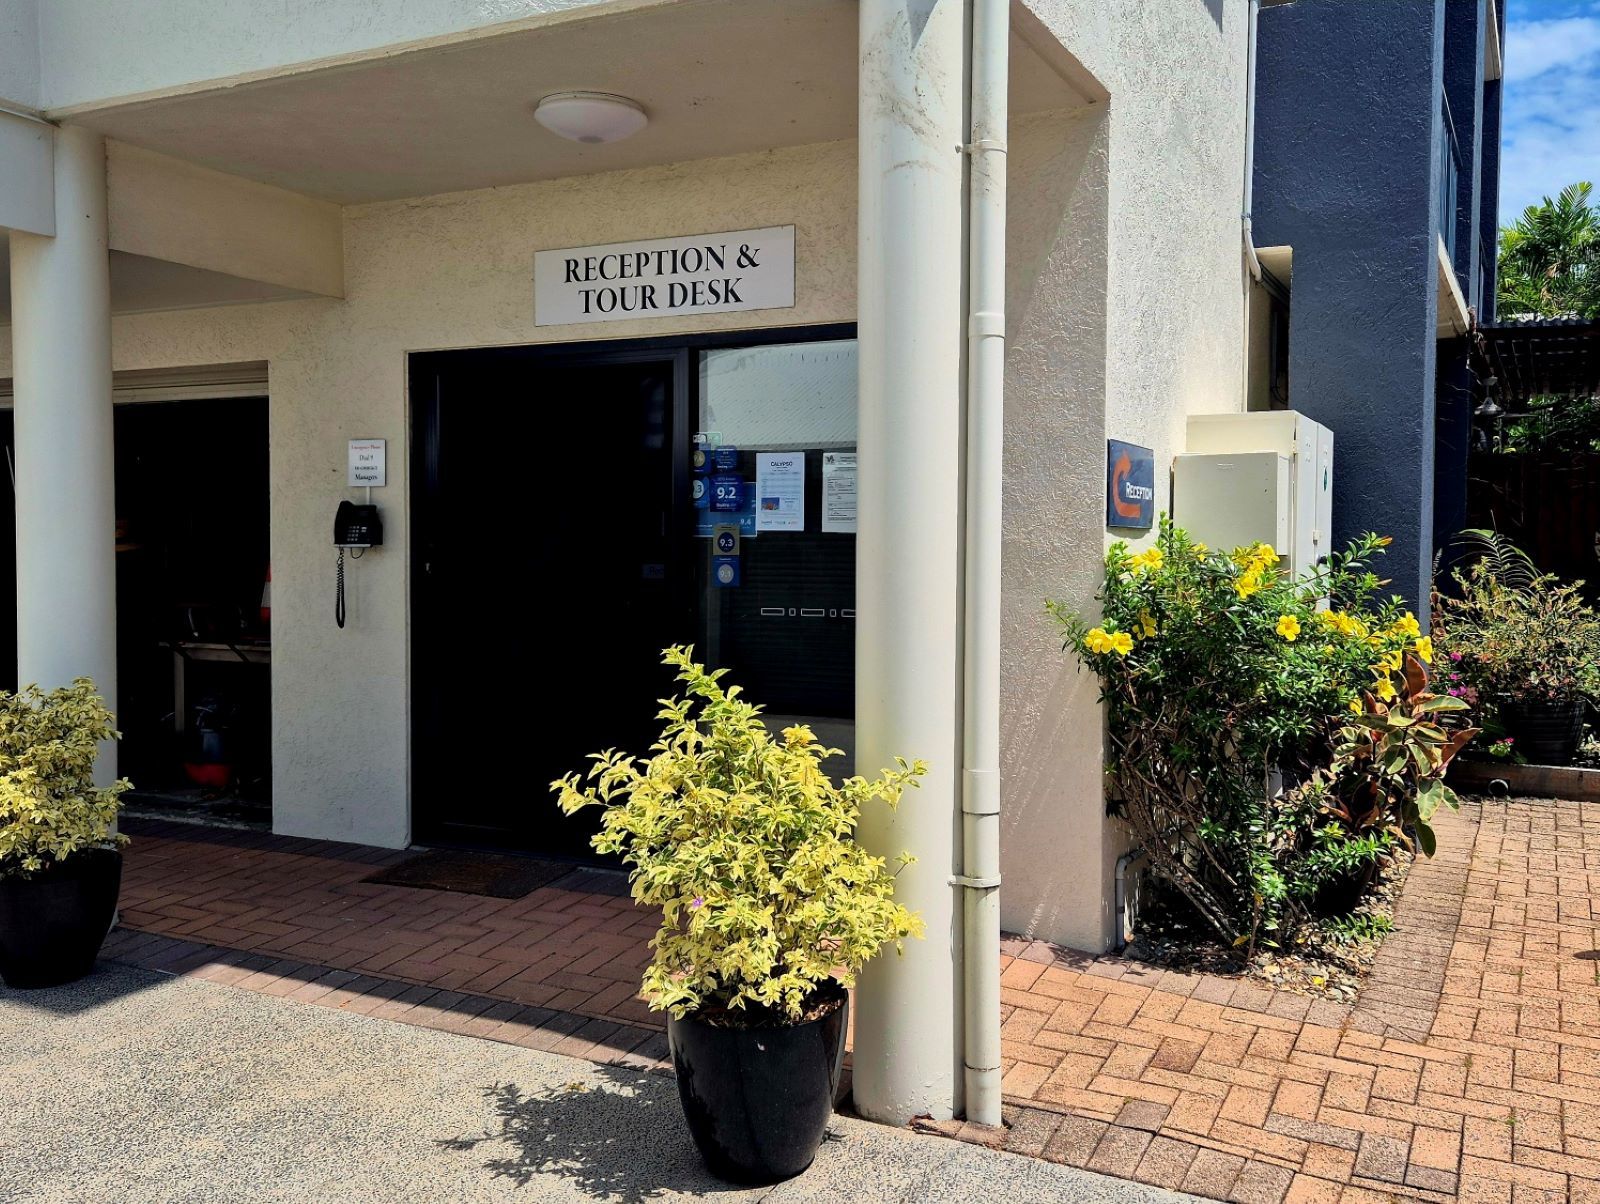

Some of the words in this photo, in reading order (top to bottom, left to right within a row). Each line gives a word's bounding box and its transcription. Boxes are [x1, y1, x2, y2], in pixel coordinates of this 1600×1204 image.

[564, 245, 726, 283] RECEPTION
[736, 244, 760, 268] &
[578, 284, 658, 313] TOUR
[667, 277, 743, 308] DESK
[716, 486, 737, 499] 9.2
[719, 538, 734, 547] 9.3
